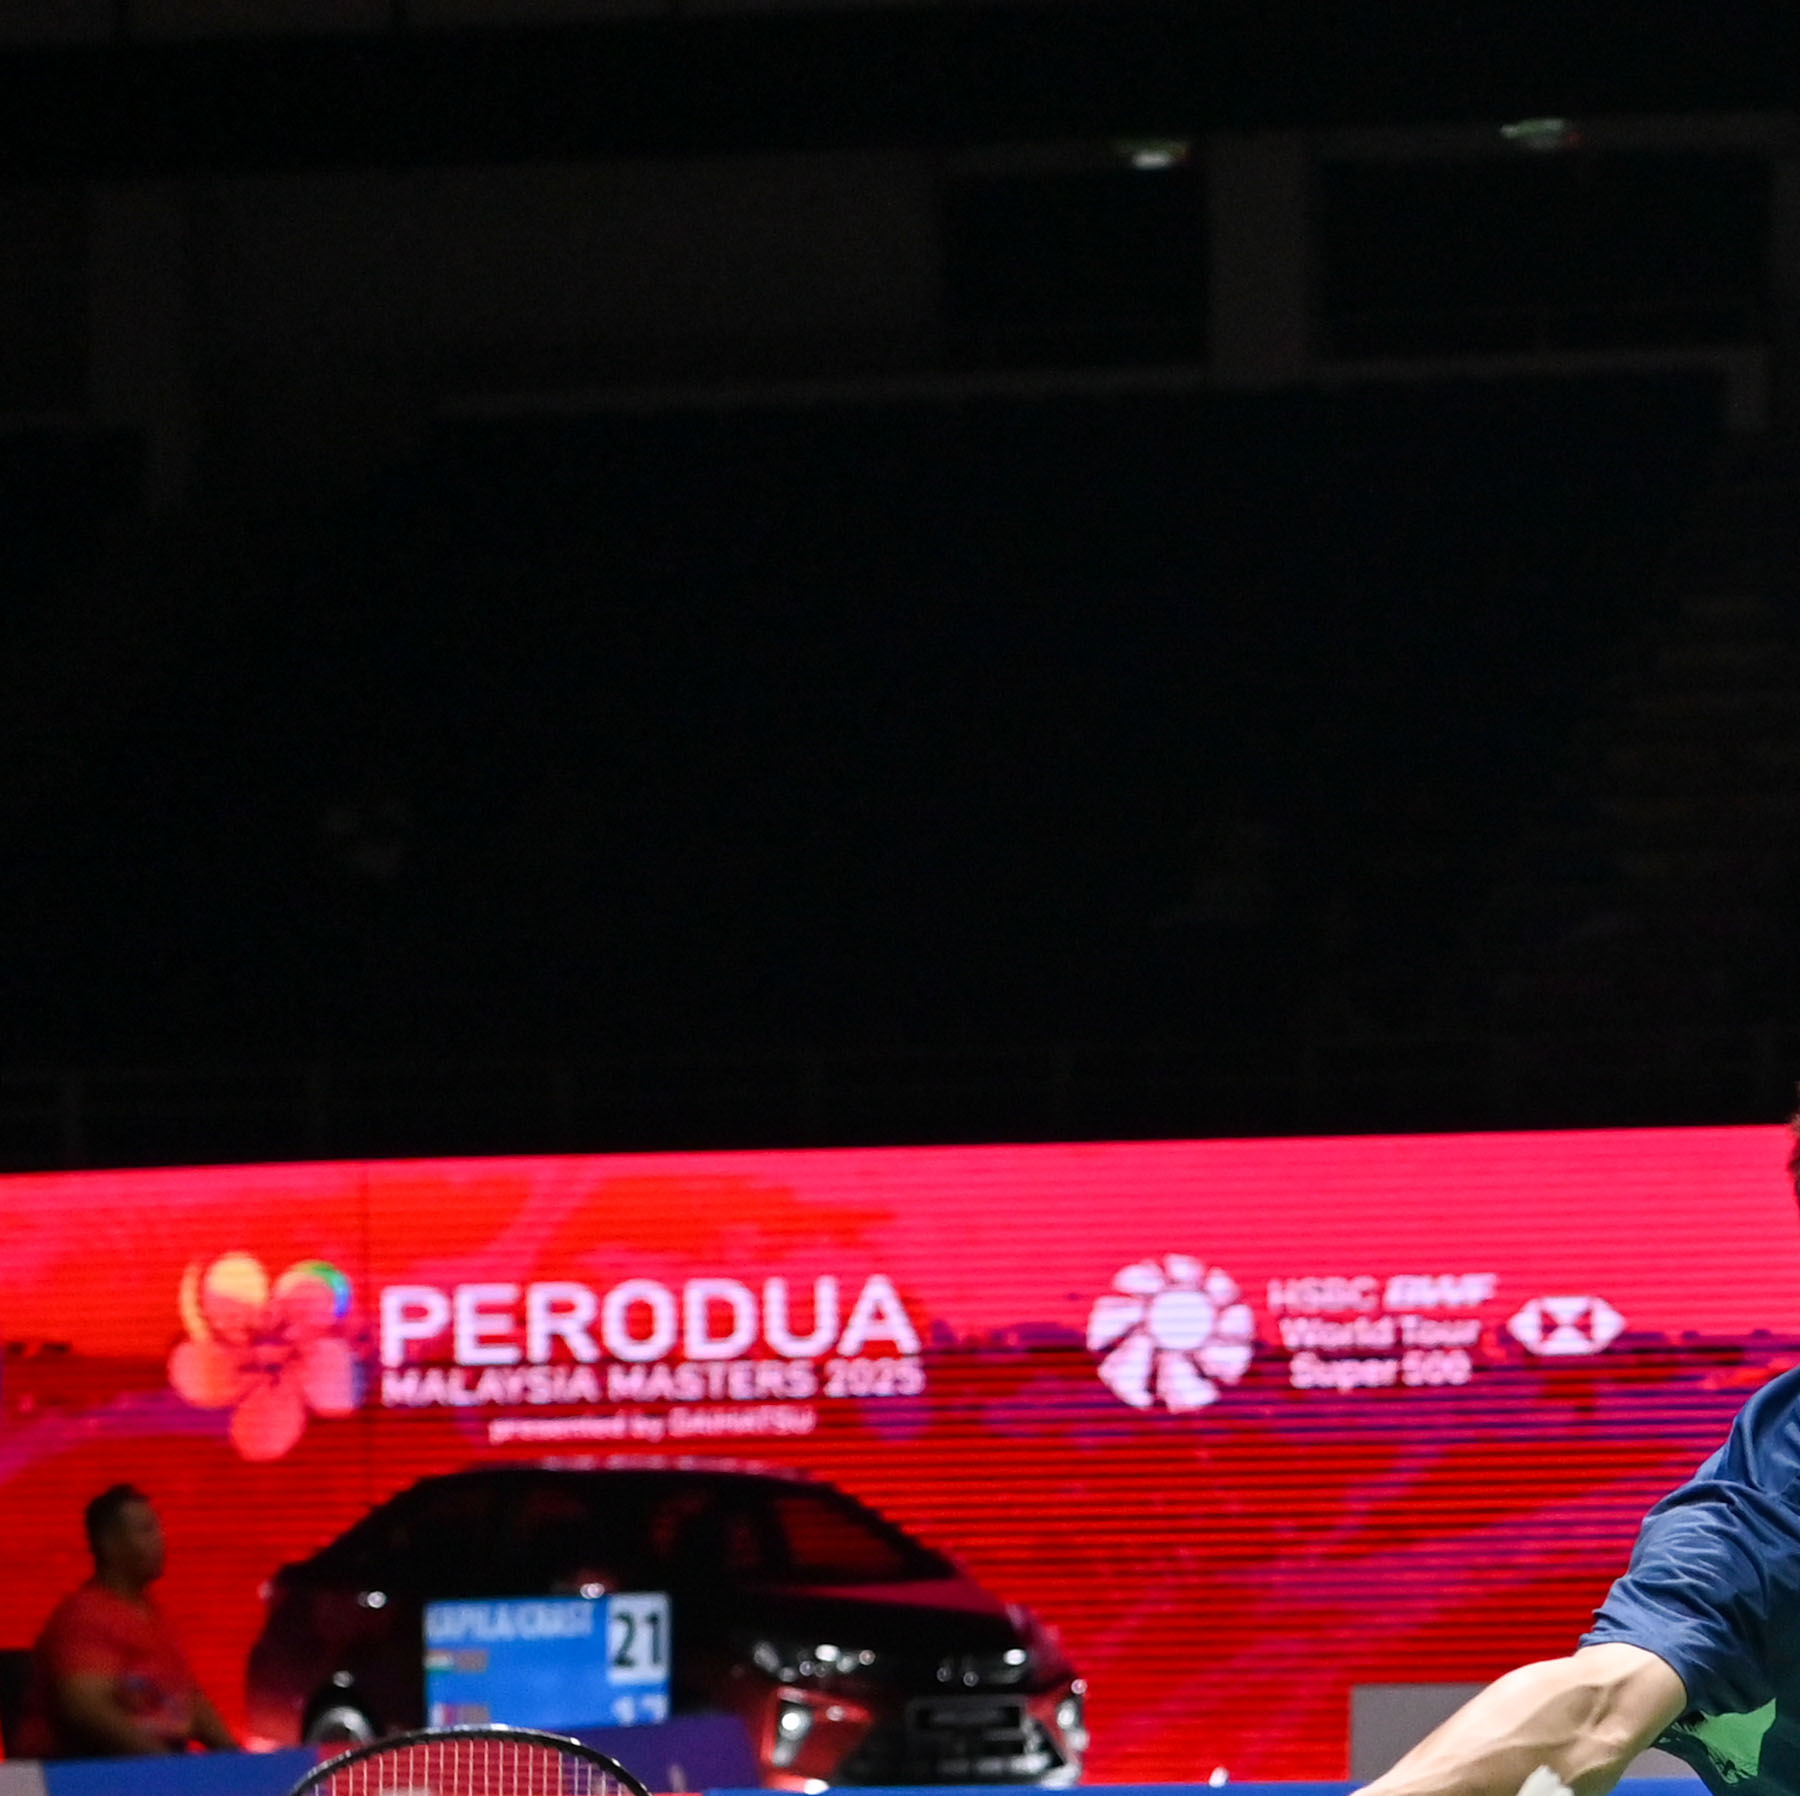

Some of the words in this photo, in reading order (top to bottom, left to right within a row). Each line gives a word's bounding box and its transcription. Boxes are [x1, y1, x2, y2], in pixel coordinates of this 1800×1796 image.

[379, 1275, 923, 1365] PERODUA
[1278, 1315, 1398, 1350] World
[1400, 1313, 1483, 1347] Tour
[381, 1365, 601, 1410] MALAYSIA
[608, 1360, 817, 1402] MASTERS
[823, 1355, 926, 1398] 2025
[612, 1610, 663, 1668] 21
